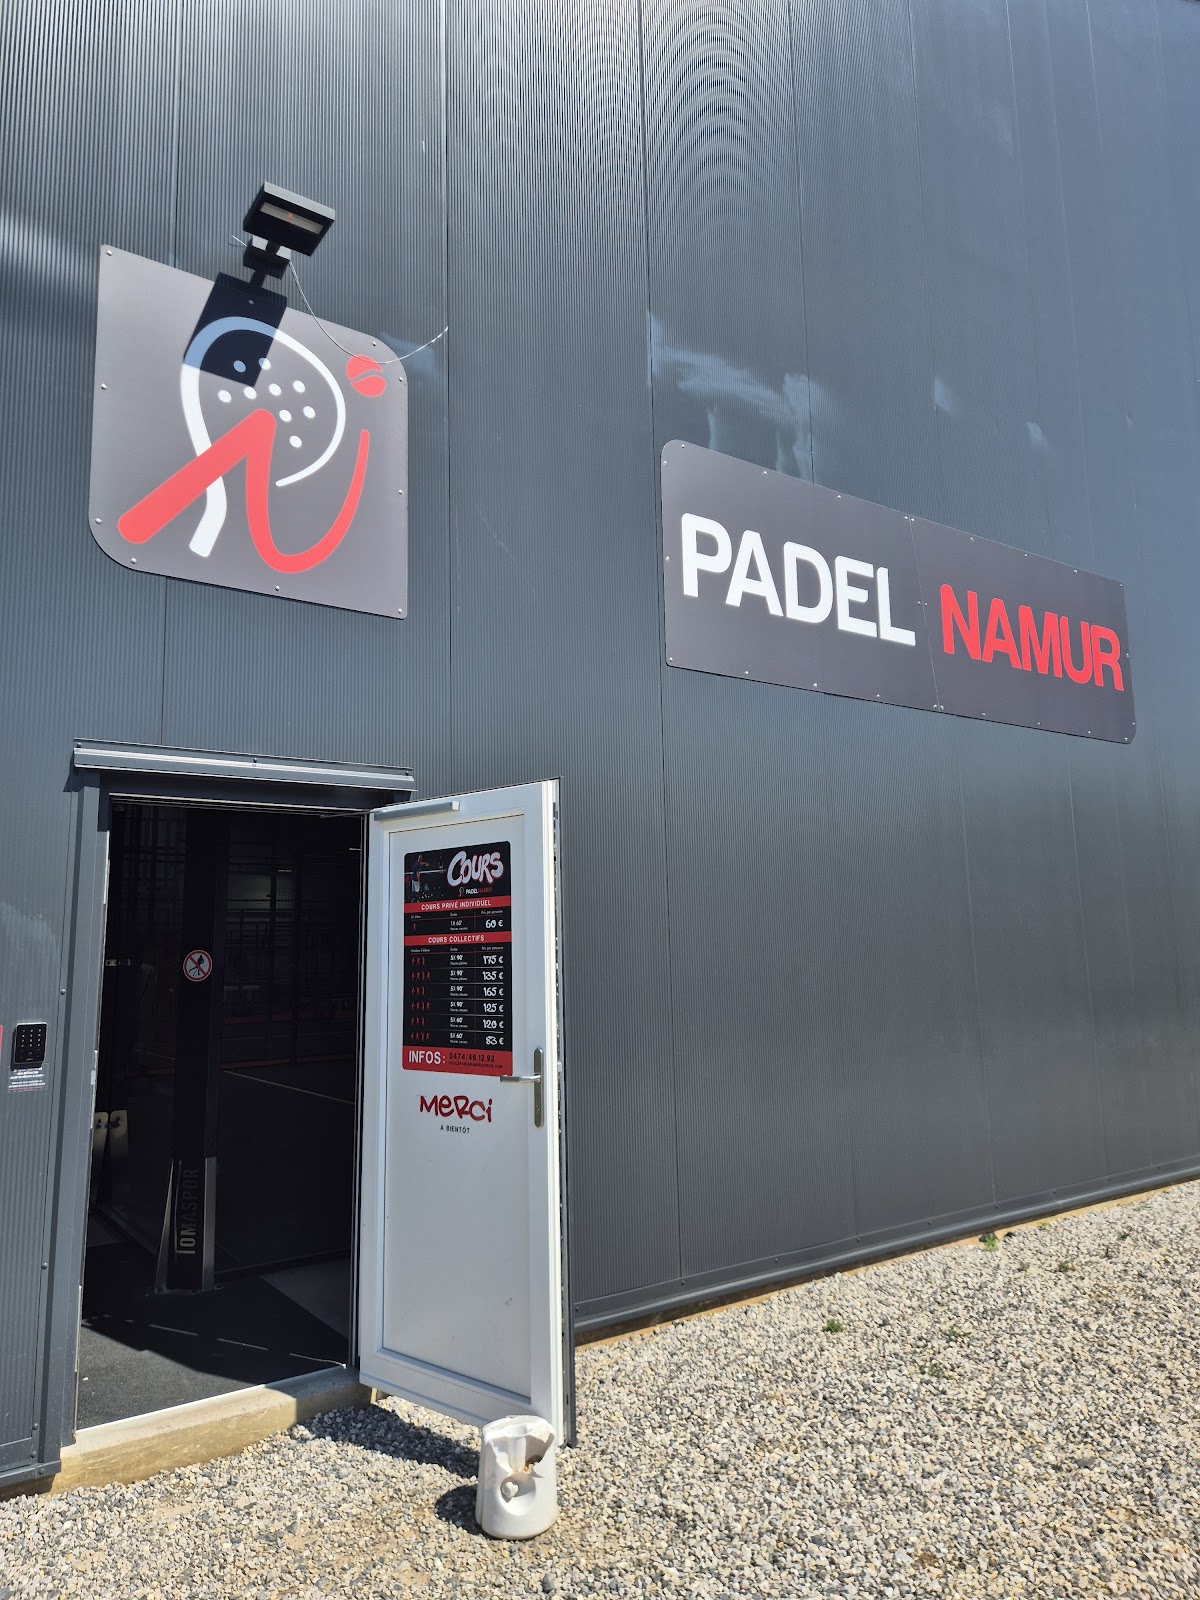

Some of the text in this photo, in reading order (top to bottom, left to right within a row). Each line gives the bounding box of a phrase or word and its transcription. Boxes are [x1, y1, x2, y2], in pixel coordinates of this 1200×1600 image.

[681, 513, 1124, 691] PADEL NAMUR
[447, 851, 504, 886] COURS
[442, 900, 458, 909] PRIVÉ
[460, 900, 492, 908] INDIVIDUEL
[486, 919, 497, 928] 60
[483, 955, 504, 964] 175 €
[482, 971, 504, 980] 135 €
[483, 987, 504, 996] 165 €
[483, 1003, 504, 1012] 125 €
[483, 1019, 504, 1029] 120 €
[486, 1036, 504, 1045] 83 €
